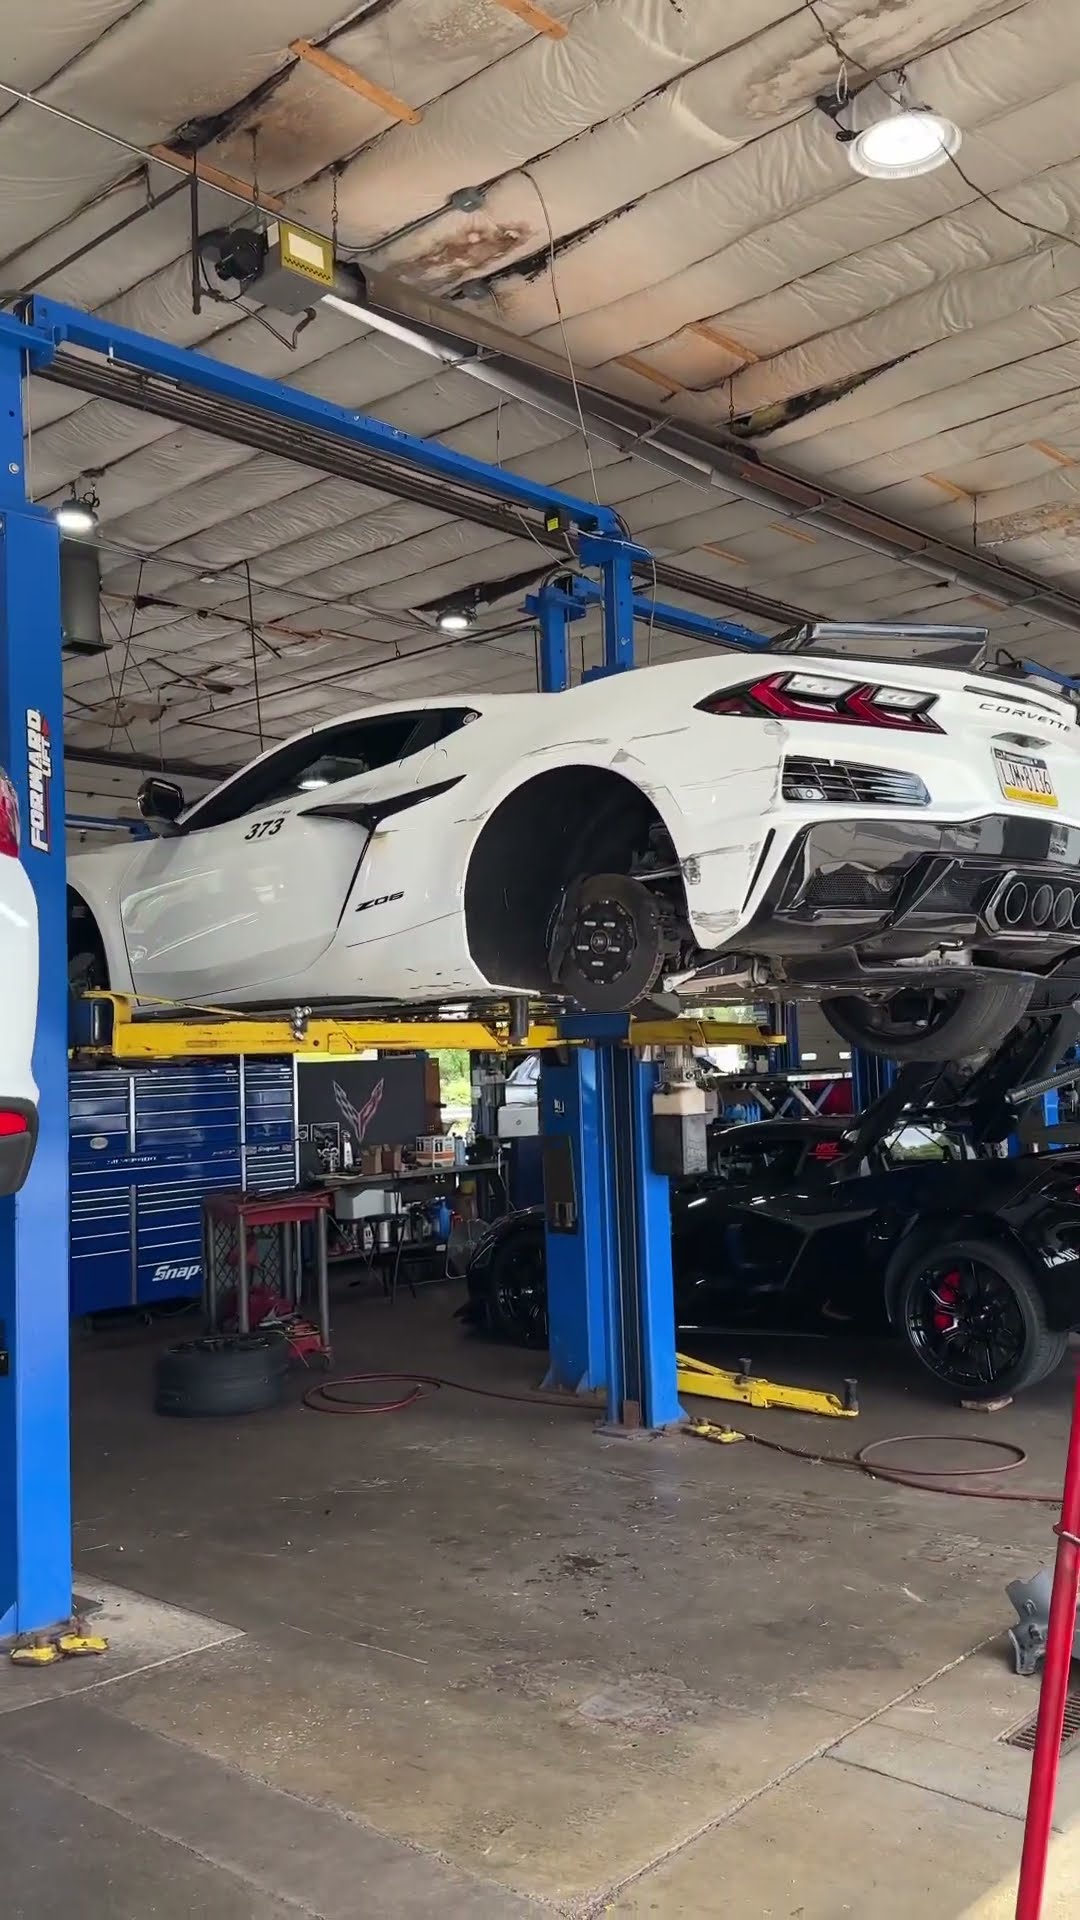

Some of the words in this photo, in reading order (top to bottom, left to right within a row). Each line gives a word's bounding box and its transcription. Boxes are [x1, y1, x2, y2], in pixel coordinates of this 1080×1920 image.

[979, 703, 1072, 732] CORVETTE
[26, 709, 49, 853] FORWARD
[244, 817, 285, 841] 373
[355, 890, 405, 912] Z06
